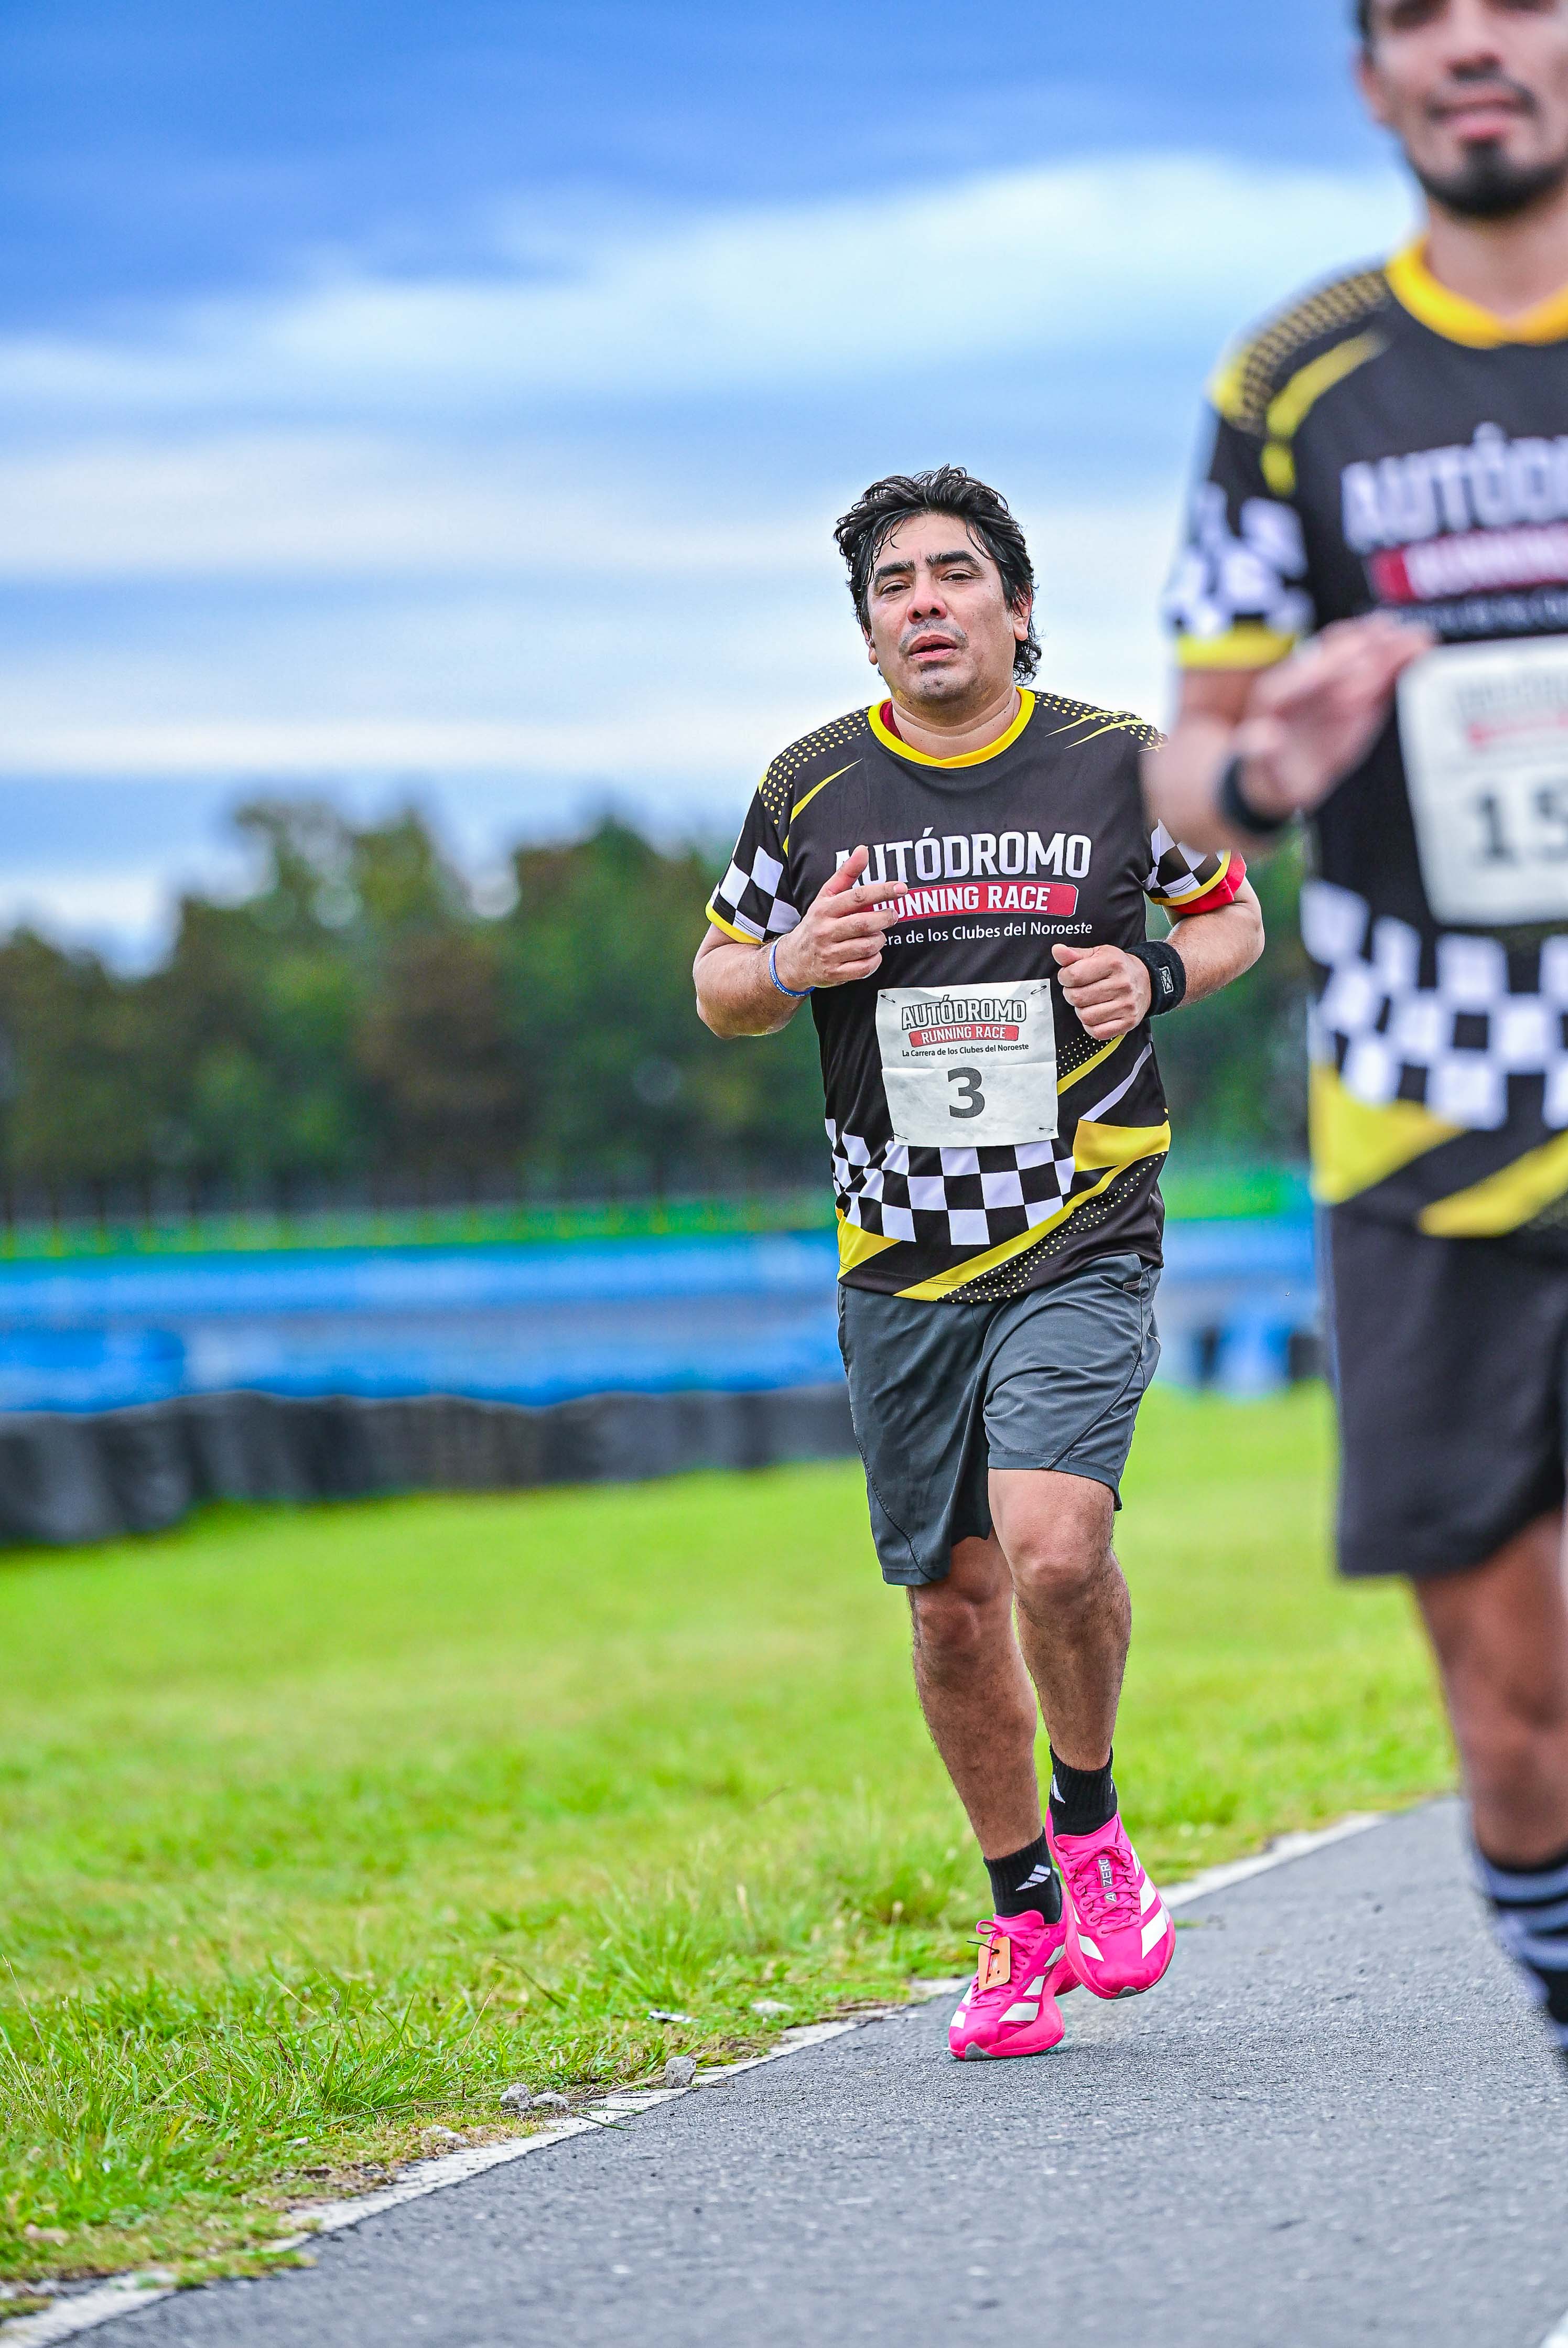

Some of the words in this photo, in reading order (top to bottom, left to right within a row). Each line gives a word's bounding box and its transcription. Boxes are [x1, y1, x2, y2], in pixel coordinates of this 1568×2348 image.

[988, 885, 1051, 911] RACE
[905, 930, 924, 944] de
[928, 929, 948, 942] los
[953, 924, 1000, 940] Clubes
[1003, 922, 1026, 936] del
[1030, 921, 1093, 935] Noroeste
[902, 994, 1026, 1030] AUTÓDROMO
[921, 1026, 971, 1044] RUNNING
[976, 1026, 1007, 1039] RACE
[985, 1044, 996, 1052] del
[998, 1043, 1029, 1052] Noroeste
[946, 1067, 986, 1119] 3
